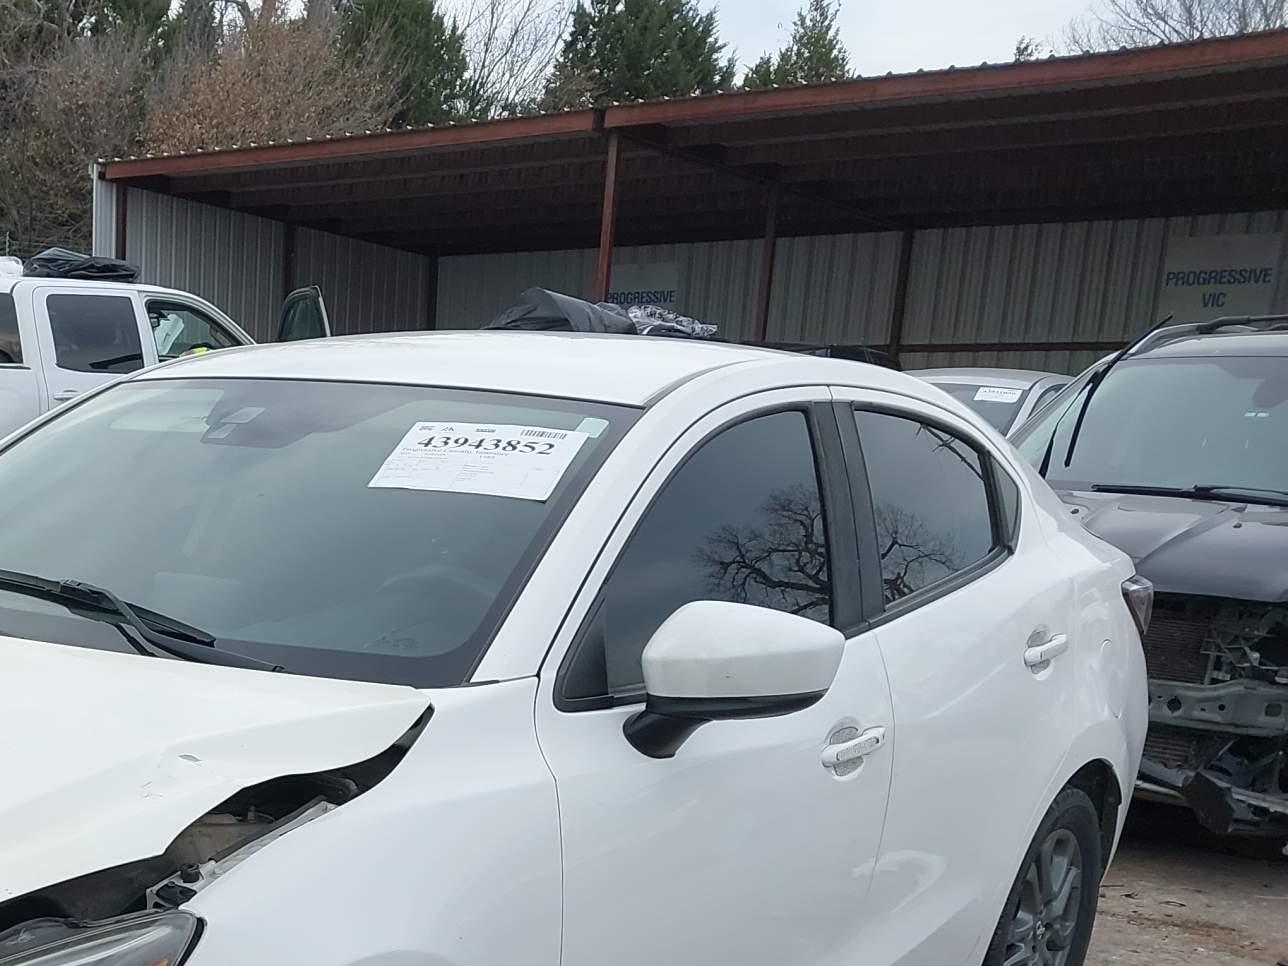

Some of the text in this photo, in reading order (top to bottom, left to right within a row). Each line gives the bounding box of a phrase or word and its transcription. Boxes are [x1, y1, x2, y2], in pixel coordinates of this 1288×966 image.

[1165, 267, 1273, 287] PROGRESSIVE
[607, 290, 676, 305] PROGRESSIVE
[1202, 292, 1227, 308] VIC
[417, 435, 556, 455] 43943852
